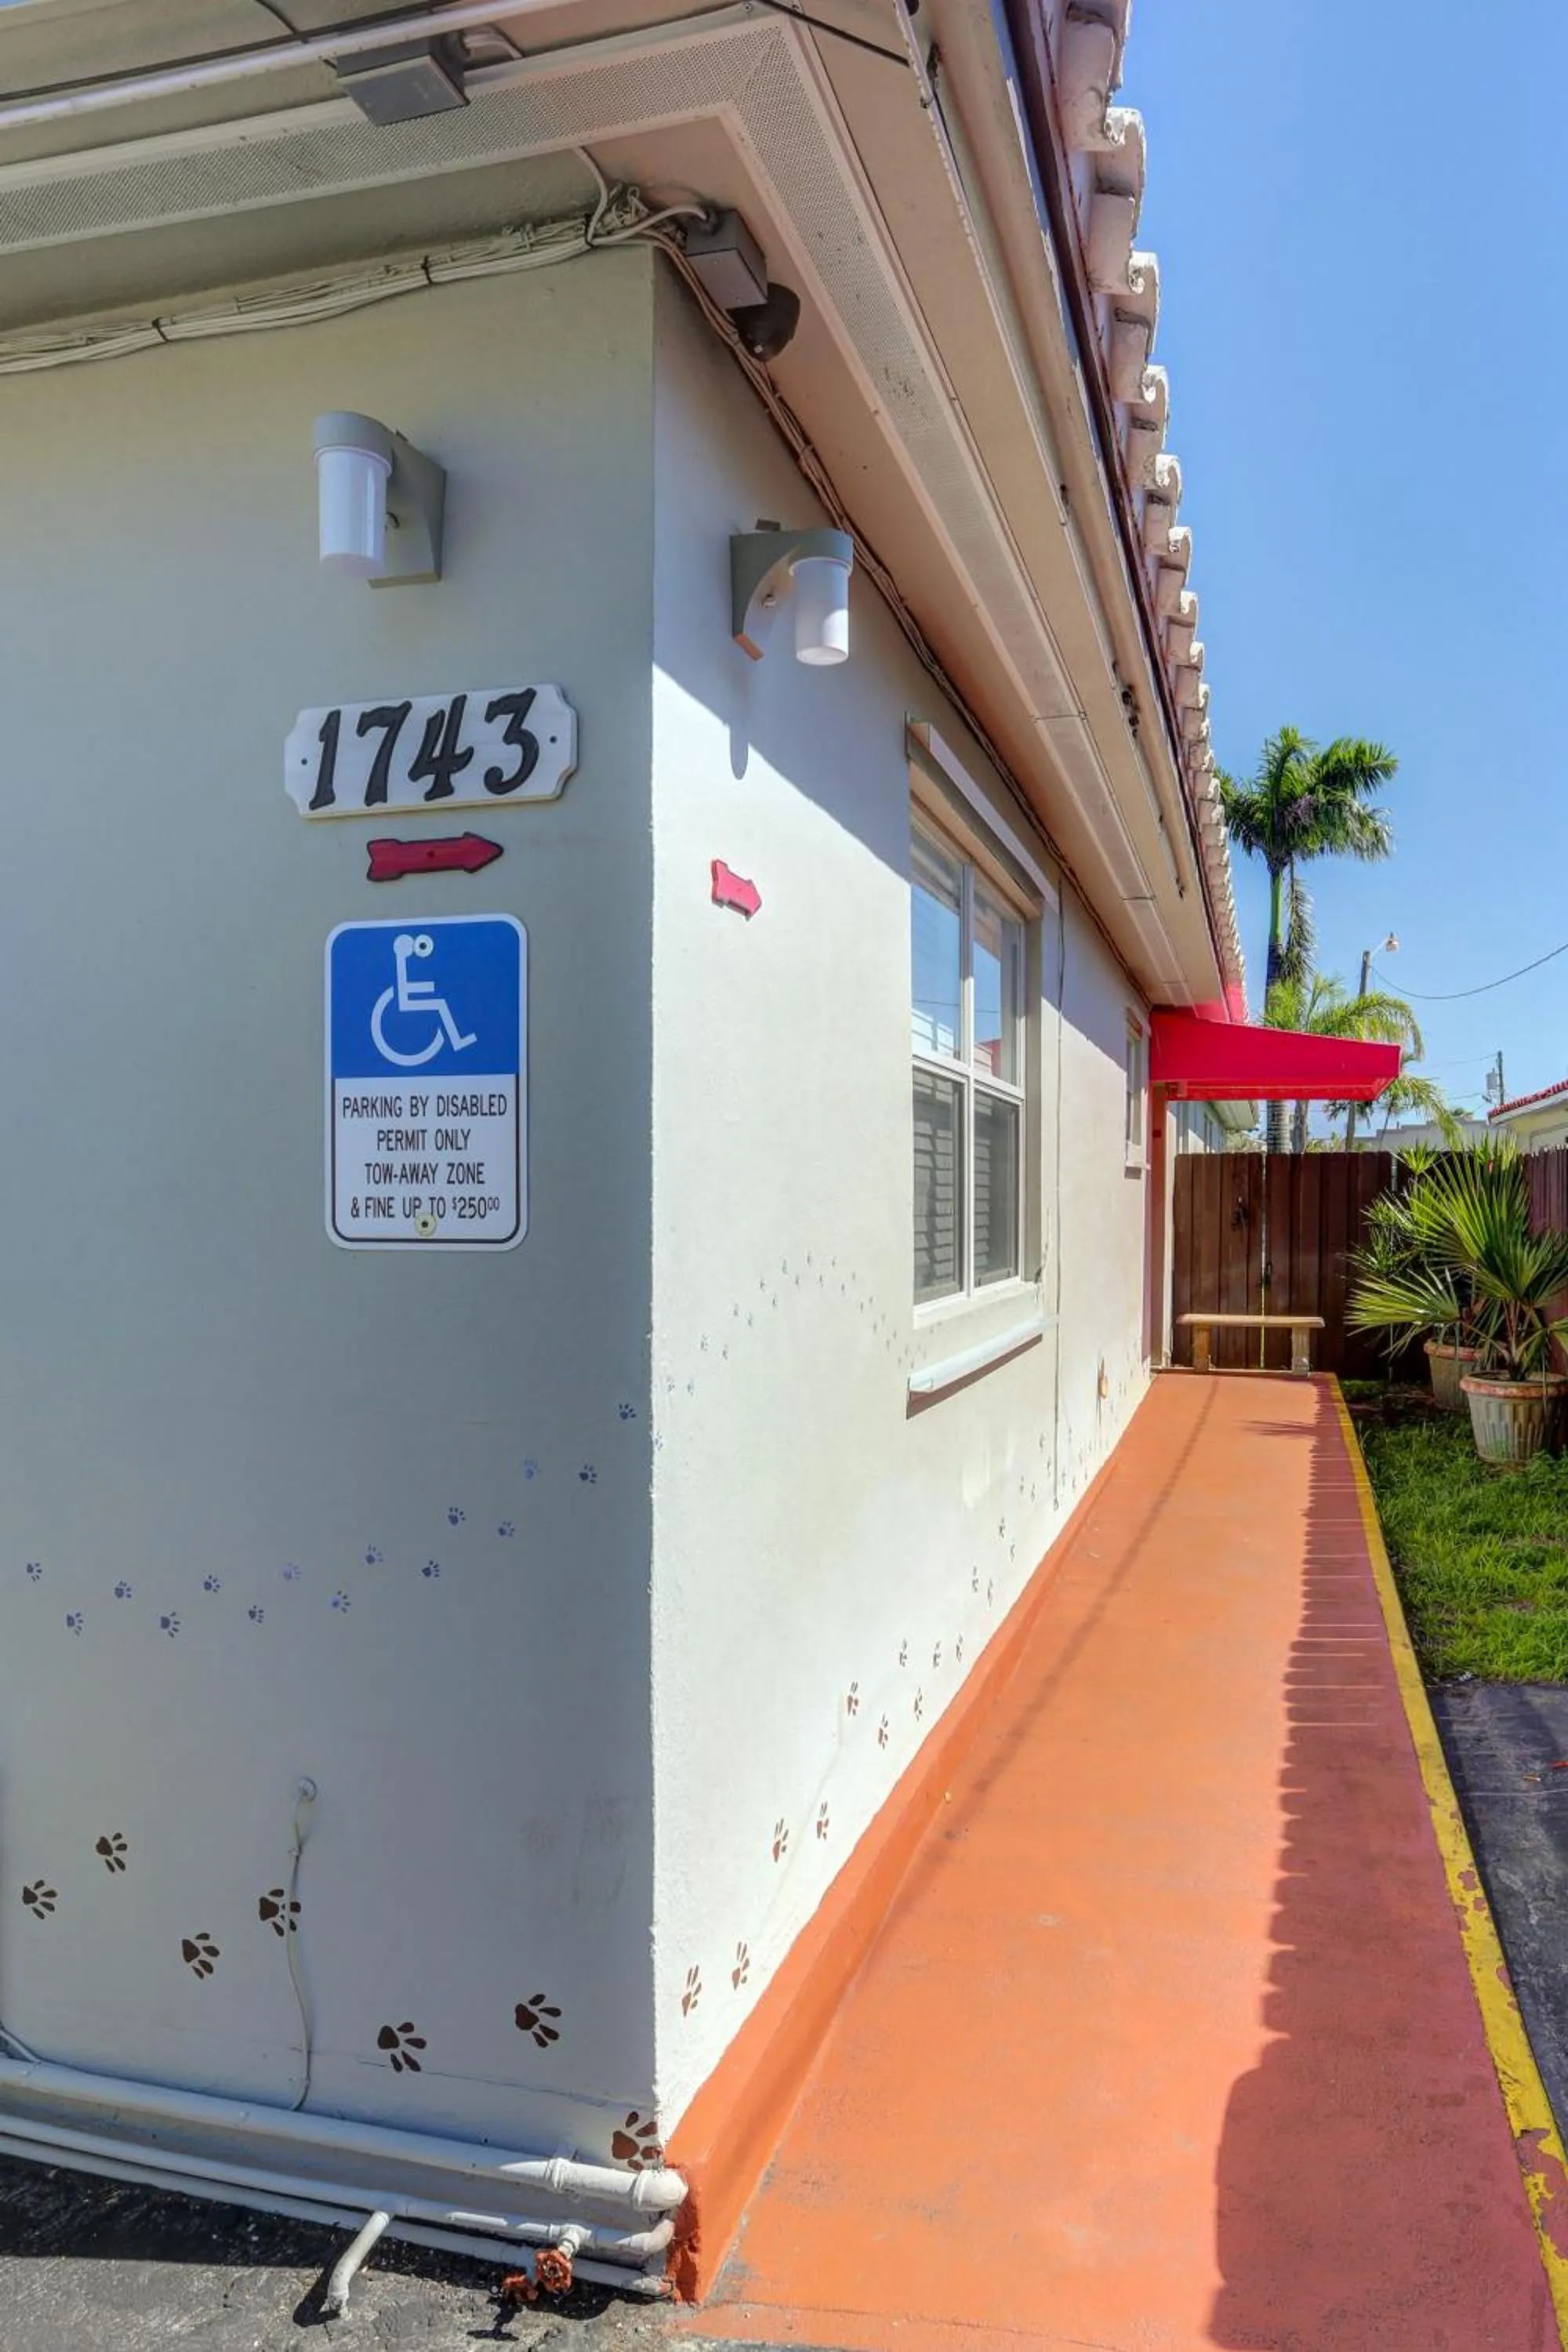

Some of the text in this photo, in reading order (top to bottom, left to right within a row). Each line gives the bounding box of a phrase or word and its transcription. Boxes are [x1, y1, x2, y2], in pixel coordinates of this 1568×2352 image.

[309, 688, 539, 811] 1743
[343, 1094, 507, 1118] PARKING BY DISABLED
[377, 1128, 470, 1151] PERMIT ONLY
[365, 1163, 485, 1185] TOW-AWAY ZONE
[350, 1197, 360, 1218] &
[365, 1196, 395, 1218] FINE
[402, 1196, 422, 1218] UP
[429, 1196, 446, 1218] TO
